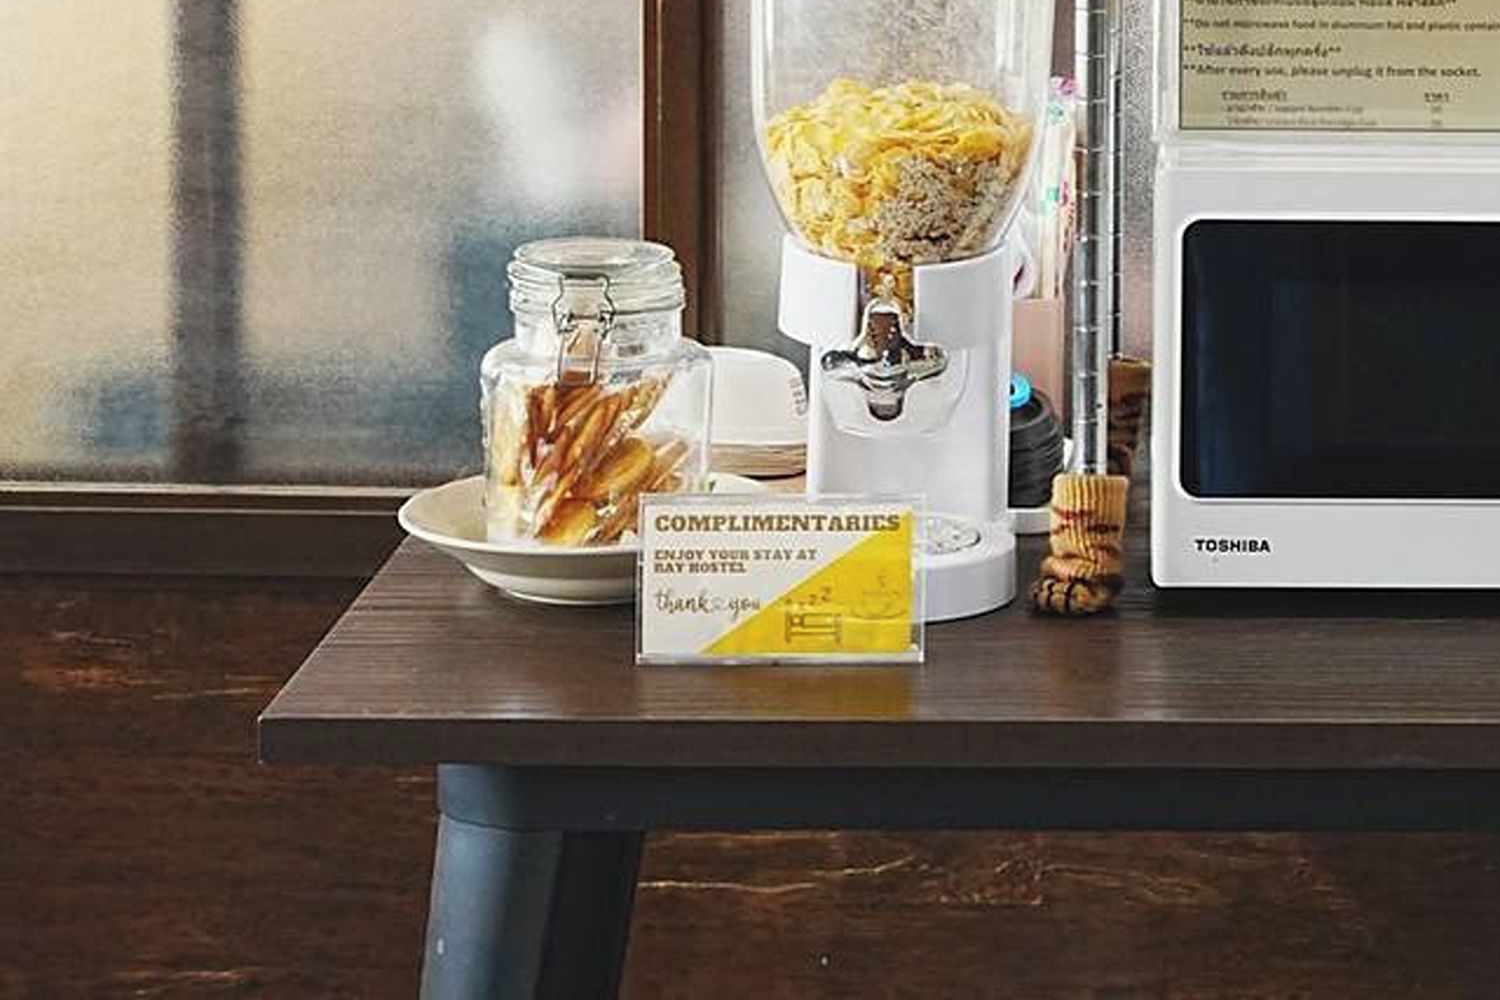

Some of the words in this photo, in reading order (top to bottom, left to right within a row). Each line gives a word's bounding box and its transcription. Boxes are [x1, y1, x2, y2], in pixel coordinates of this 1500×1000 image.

[1213, 18, 1231, 29] not
[1233, 20, 1290, 30] microwave
[1292, 19, 1316, 30] food
[1406, 20, 1426, 31] and
[1428, 20, 1461, 32] plastic
[1229, 66, 1261, 77] every
[1291, 65, 1329, 78] please
[1332, 66, 1372, 79] unplug
[1375, 66, 1384, 77] it
[1386, 65, 1416, 77] from
[1418, 65, 1437, 77] the
[1440, 66, 1482, 78] socket.
[654, 514, 900, 533] COMPLIMENTARIES
[1195, 538, 1271, 553] TOSHIBA
[654, 549, 705, 561] ENJOY
[708, 549, 750, 561] YOUR
[752, 549, 793, 561] STAY
[796, 549, 817, 561] AT
[688, 562, 747, 574] HOSTEL
[655, 587, 709, 615] thank
[728, 596, 761, 623] you
